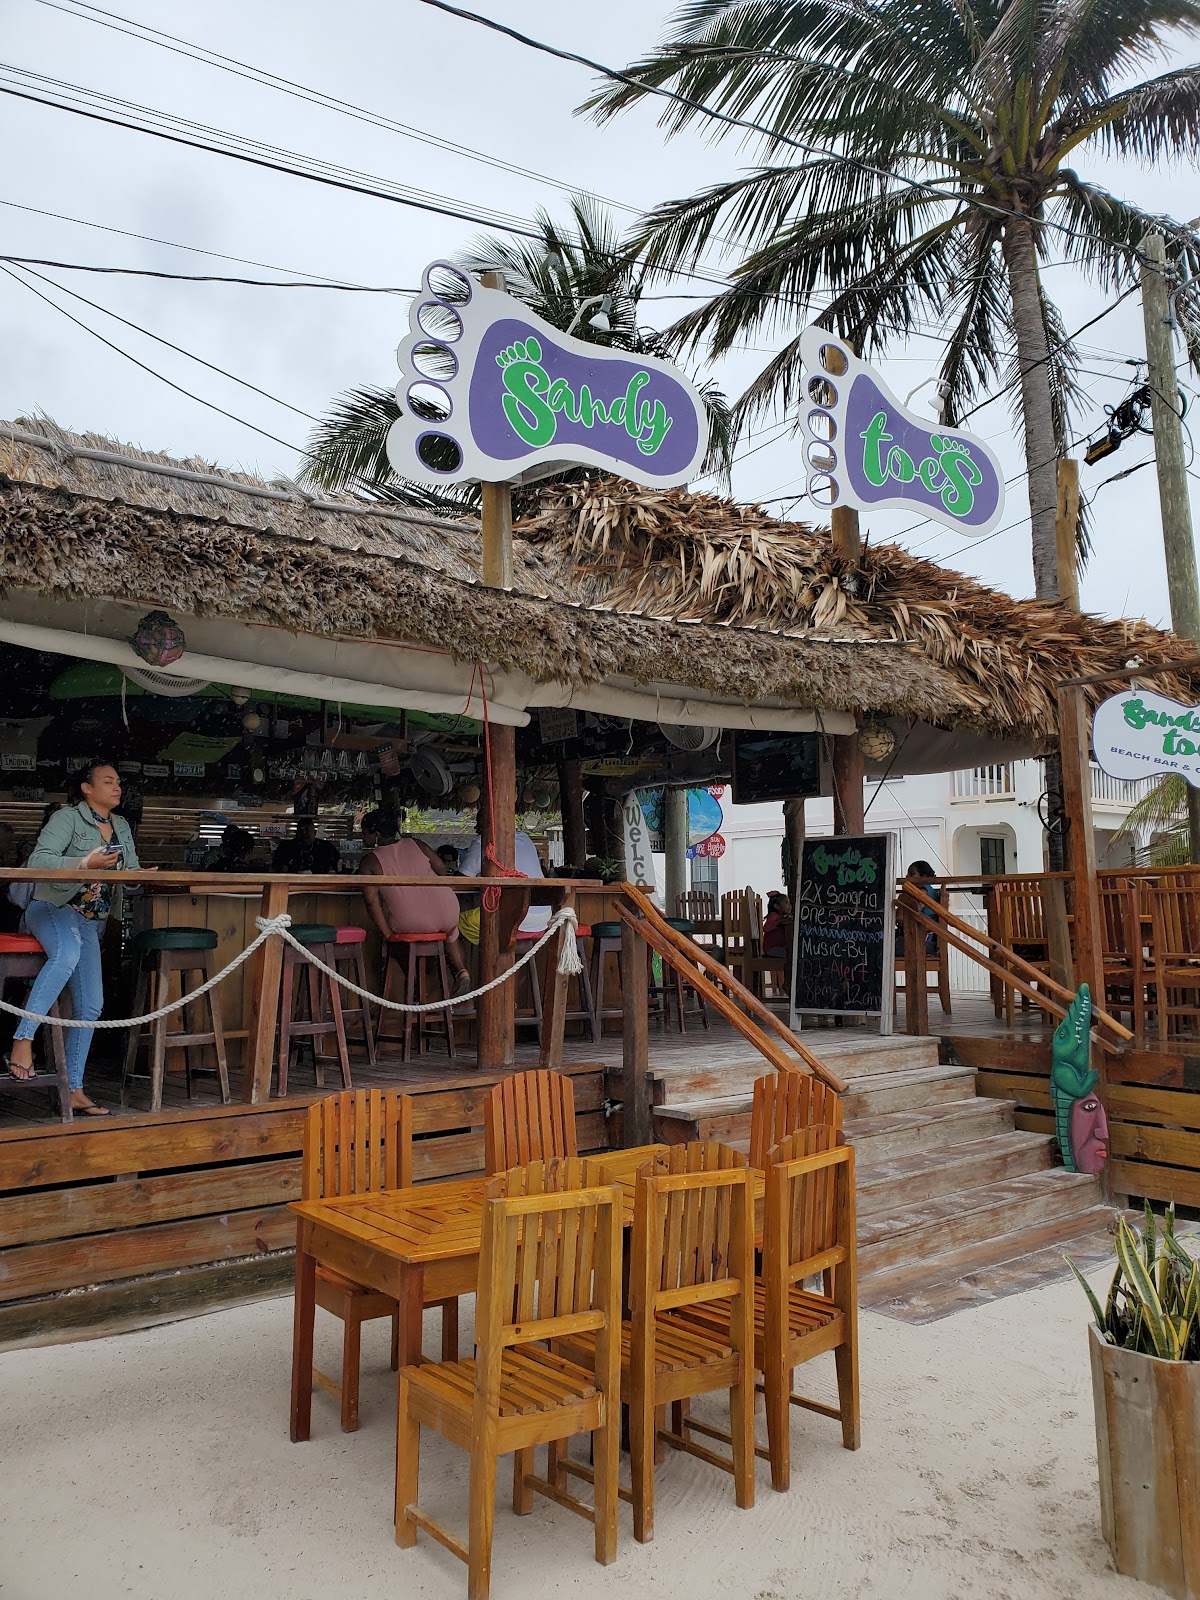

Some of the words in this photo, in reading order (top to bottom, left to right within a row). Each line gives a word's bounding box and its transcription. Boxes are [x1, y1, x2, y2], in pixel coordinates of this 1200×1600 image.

[496, 336, 673, 456] Sandy
[860, 412, 983, 517] toes
[1110, 746, 1150, 761] BEACH
[1154, 758, 1178, 768] BAR
[1163, 729, 1200, 756] to
[708, 787, 723, 795] FOOD
[813, 844, 861, 875] Sandy
[837, 857, 877, 886] toes
[827, 885, 877, 916] Sangria
